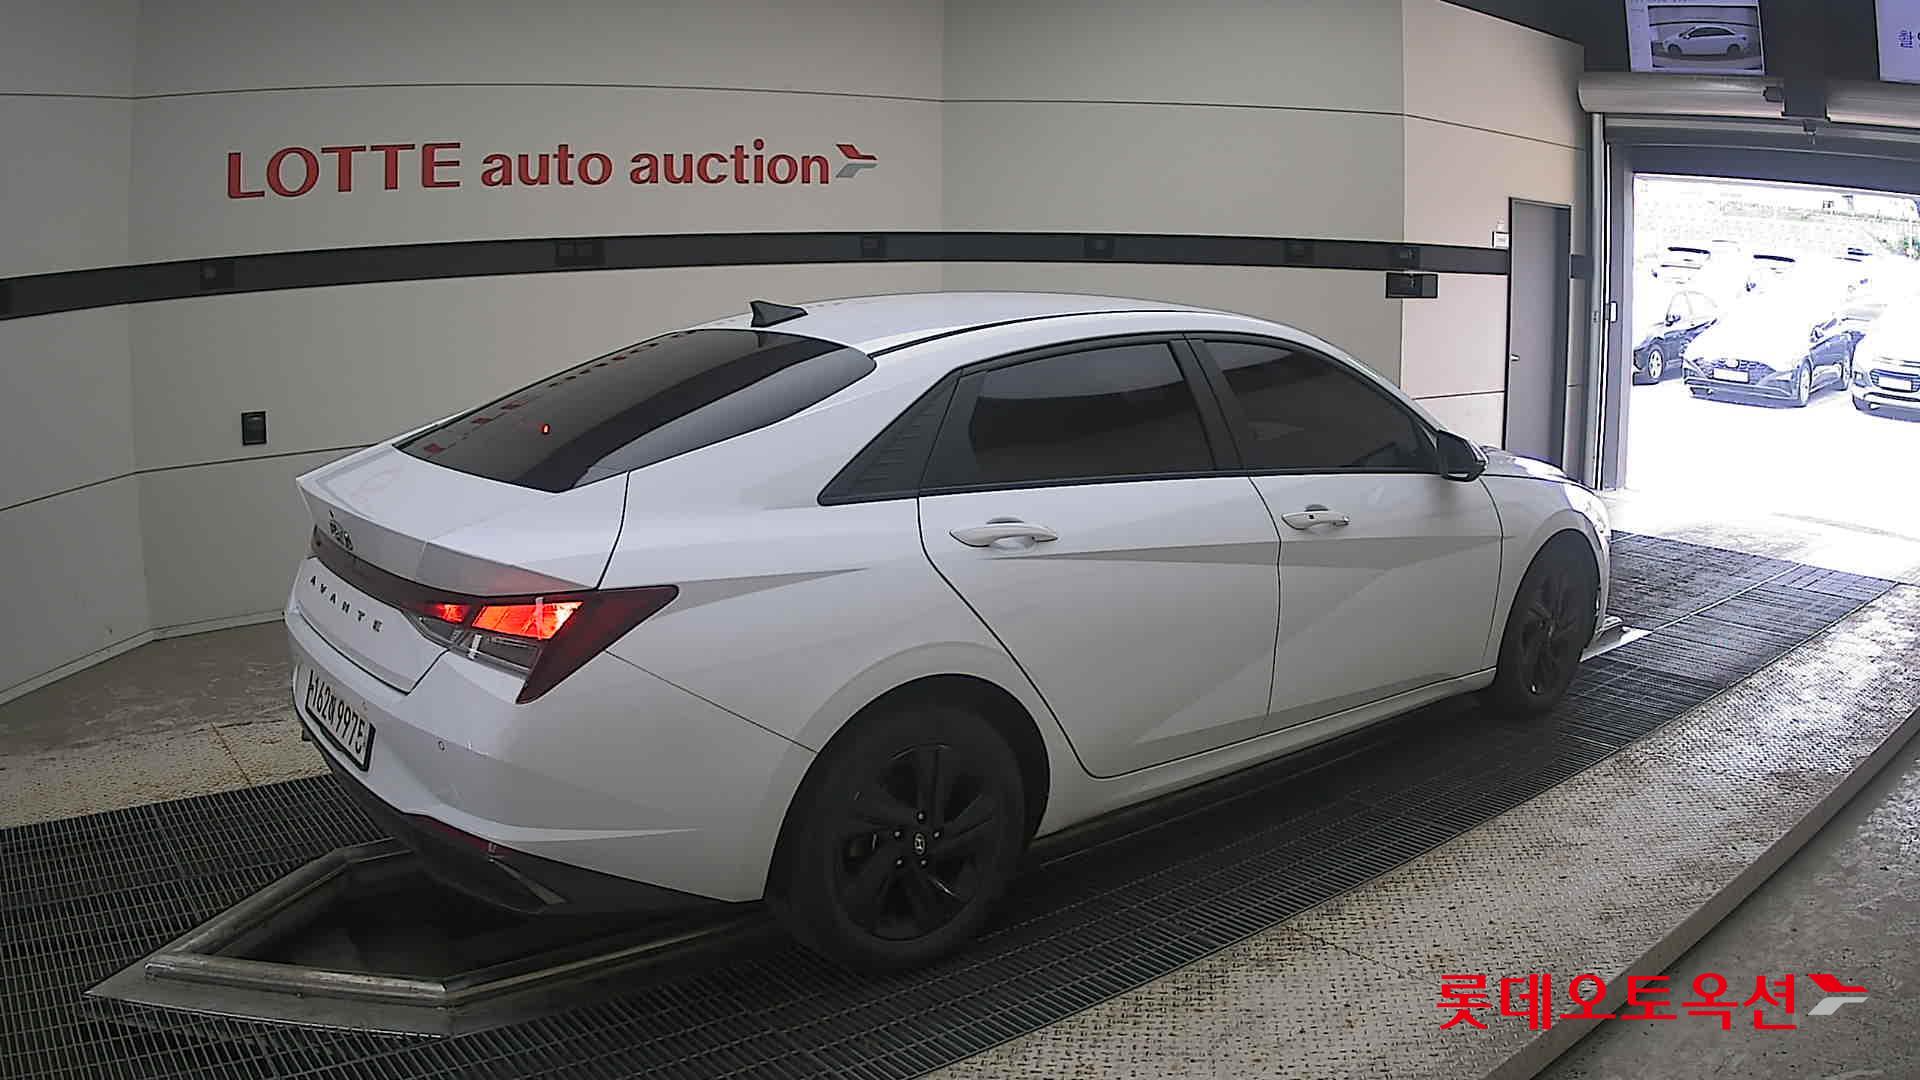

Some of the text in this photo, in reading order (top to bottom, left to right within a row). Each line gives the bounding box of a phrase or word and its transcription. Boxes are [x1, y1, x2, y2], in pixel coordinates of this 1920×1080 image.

[227, 138, 829, 199] LOTTE auto auction
[309, 574, 384, 633] AVANTE
